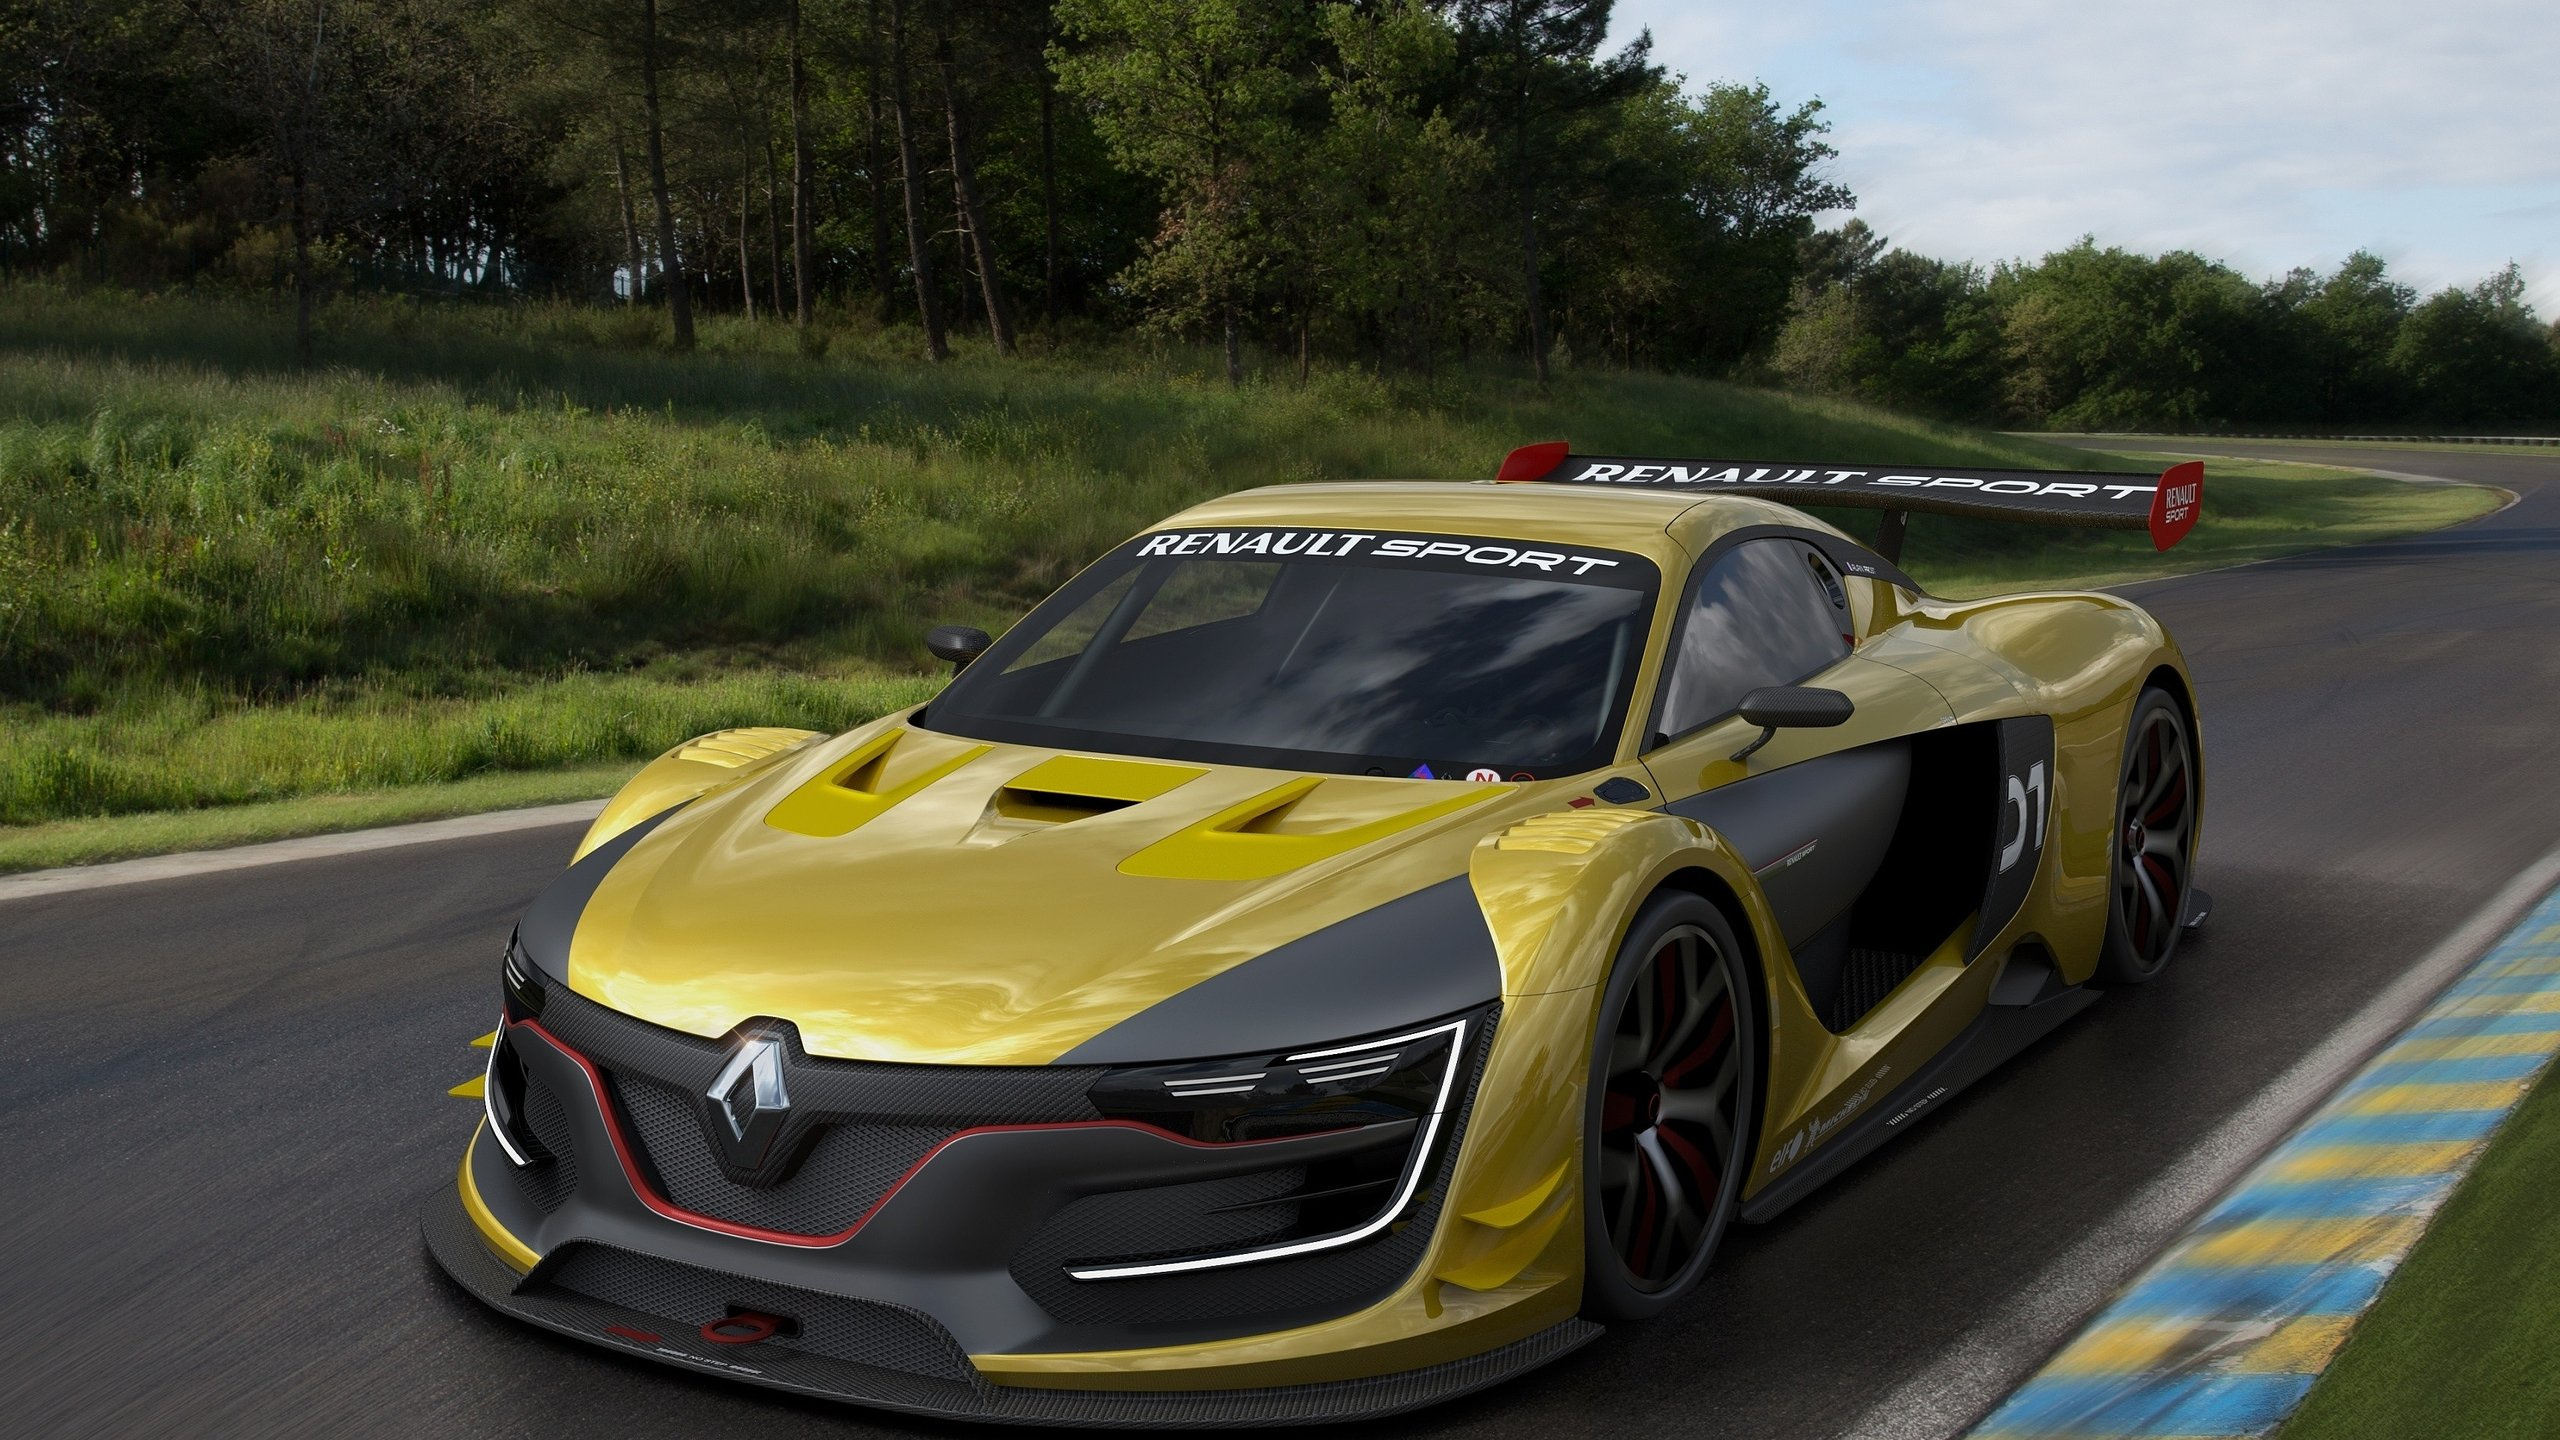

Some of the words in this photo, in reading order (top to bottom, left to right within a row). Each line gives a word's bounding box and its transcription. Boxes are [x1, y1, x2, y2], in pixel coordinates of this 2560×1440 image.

[1572, 463, 1868, 484] RENAULT
[1866, 475, 2158, 500] SPORT
[2165, 483, 2197, 509] RENAULT
[2165, 506, 2189, 524] SPORT
[1136, 532, 1377, 557] RENAULT
[1370, 539, 1620, 576] SPORT
